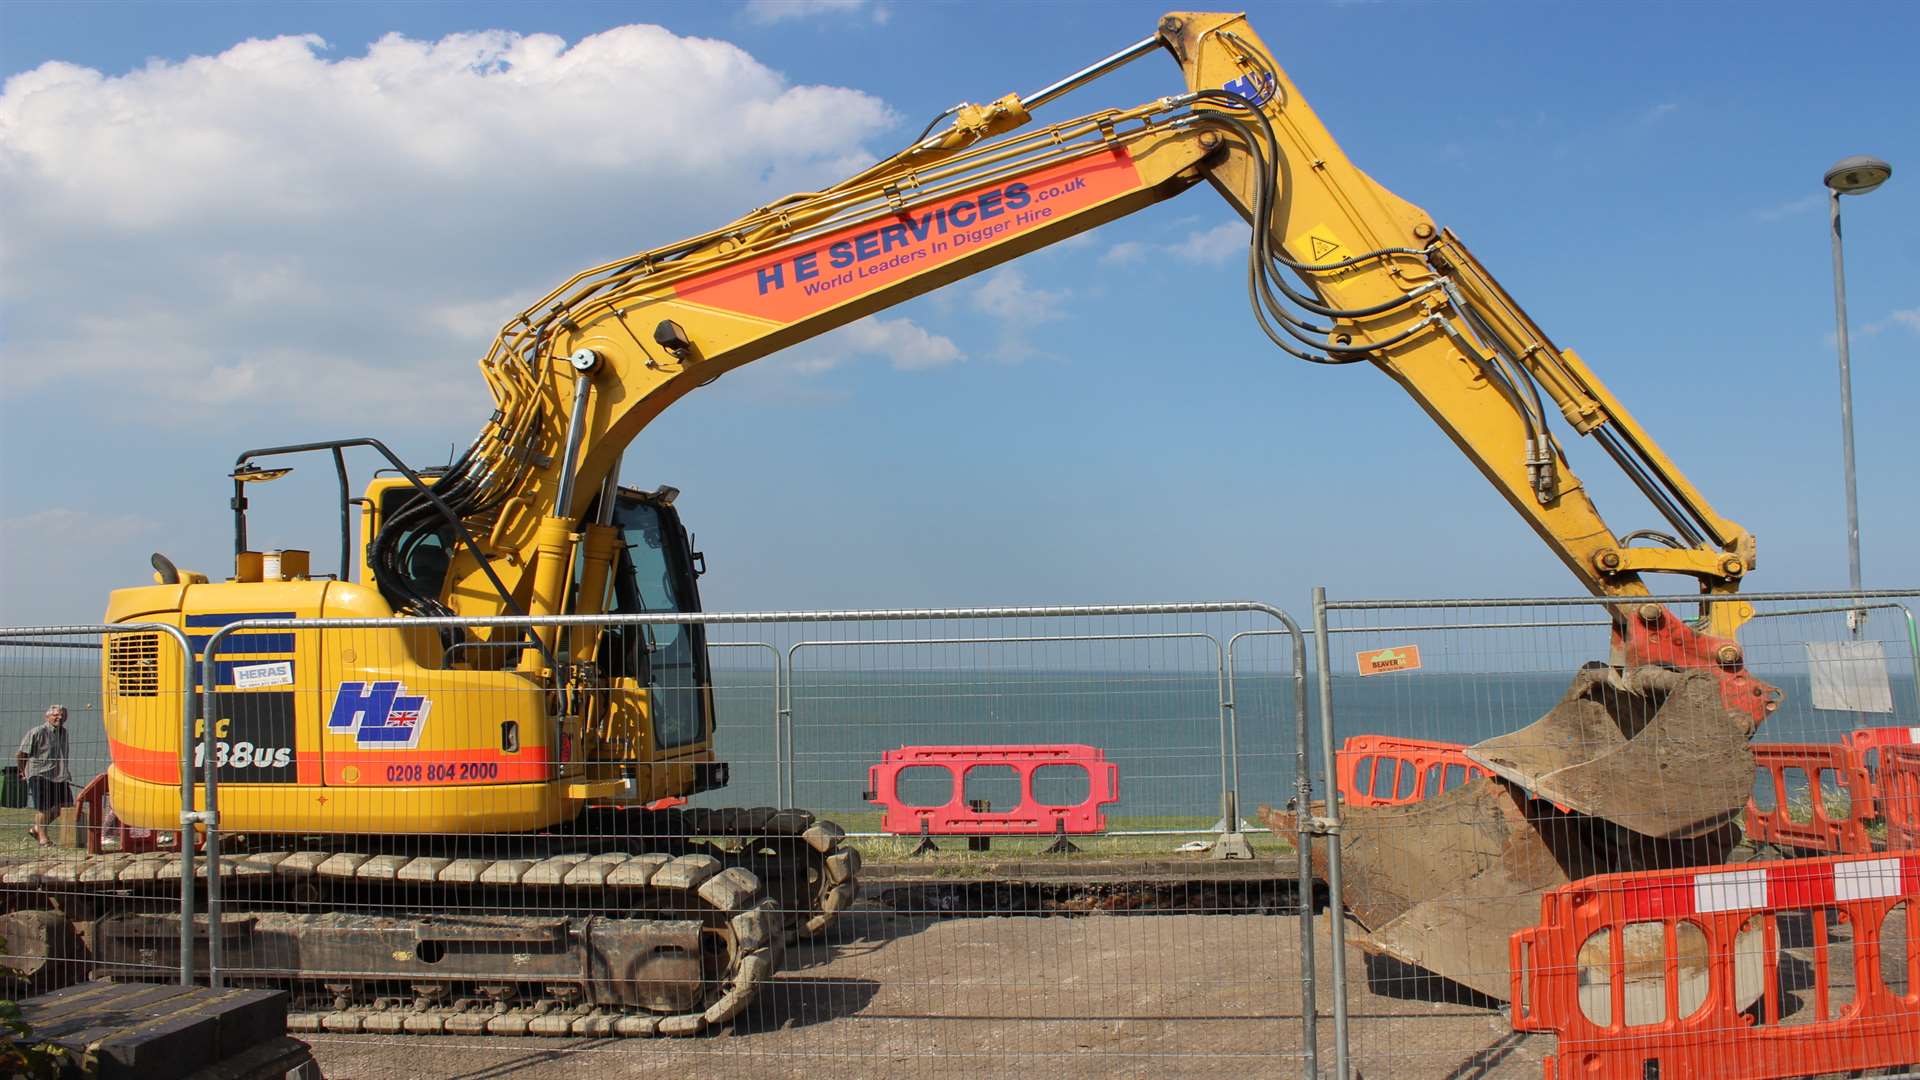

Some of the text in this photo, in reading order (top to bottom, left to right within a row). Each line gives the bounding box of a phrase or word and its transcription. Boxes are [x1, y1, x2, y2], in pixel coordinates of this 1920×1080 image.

[804, 207, 1052, 296] World Leaders In Digger Hire
[757, 263, 785, 295] H
[793, 252, 819, 283] E
[239, 666, 287, 680] HERAS
[386, 762, 498, 782] 0208 804 2000
